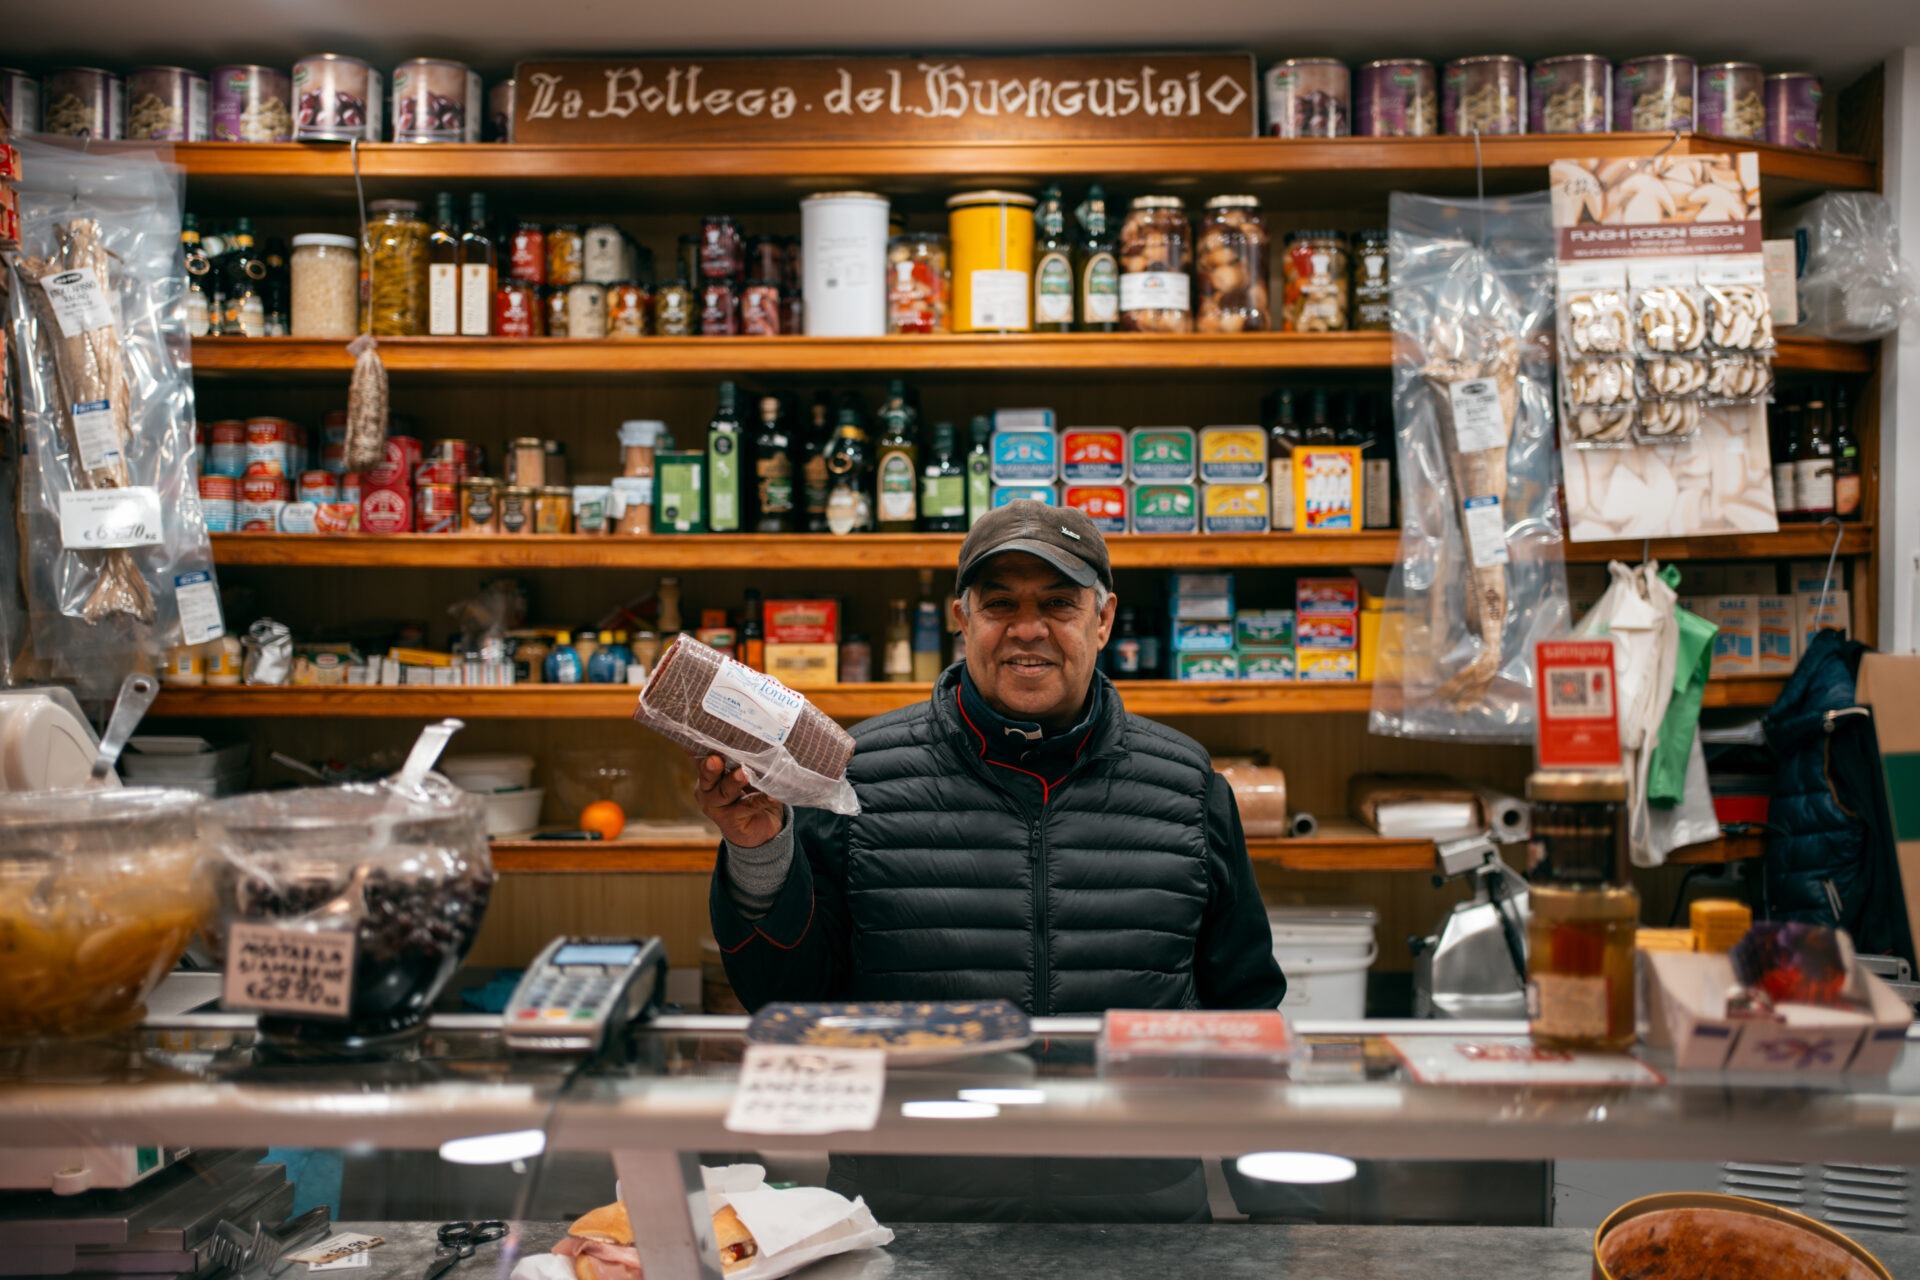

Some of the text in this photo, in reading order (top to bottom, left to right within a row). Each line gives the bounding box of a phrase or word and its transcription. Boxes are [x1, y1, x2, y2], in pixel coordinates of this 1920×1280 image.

[526, 72, 583, 121] La
[1570, 229, 1627, 242] FUNGHI
[1689, 224, 1745, 238] SECCHI
[1719, 599, 1747, 609] SALE
[759, 681, 800, 709] Tonno
